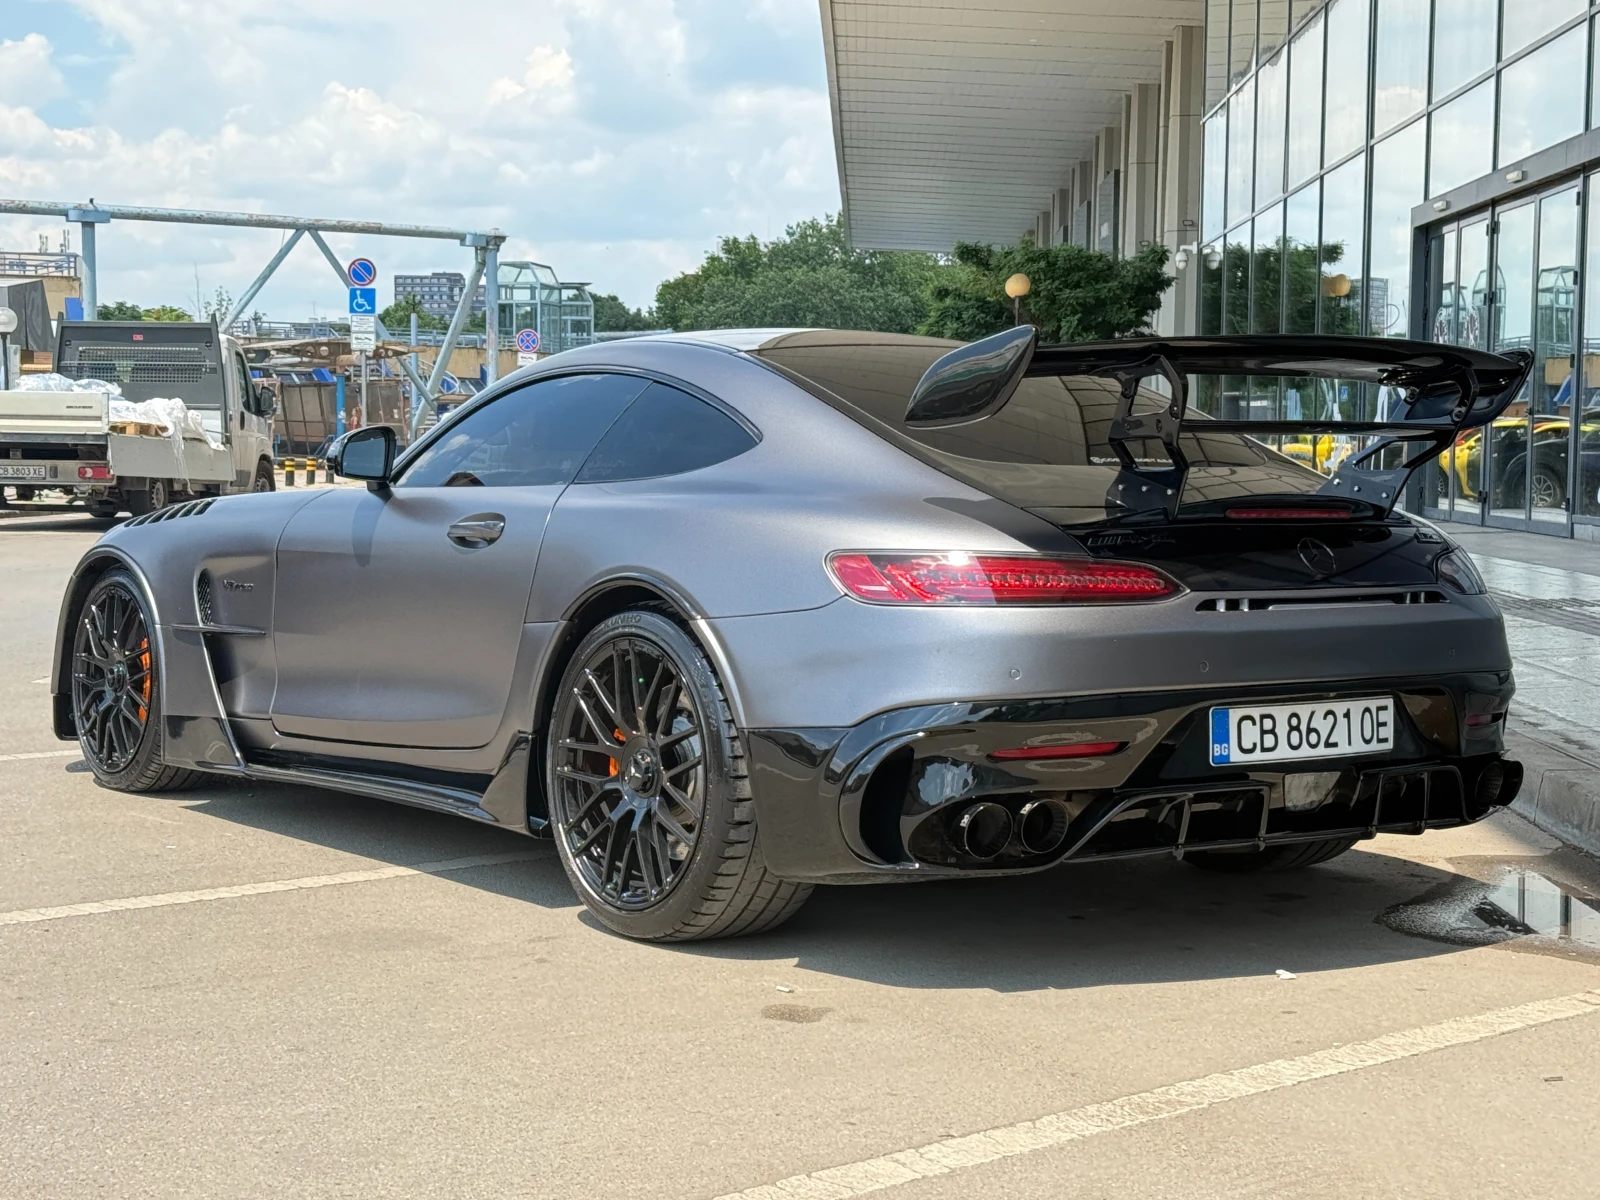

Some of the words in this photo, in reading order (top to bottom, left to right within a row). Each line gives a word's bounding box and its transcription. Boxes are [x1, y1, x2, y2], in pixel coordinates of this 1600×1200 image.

[10, 467, 31, 476] 3803
[32, 467, 44, 476] XE
[1236, 713, 1279, 755] CB
[1286, 708, 1352, 751] 8621
[1213, 743, 1229, 757] BG
